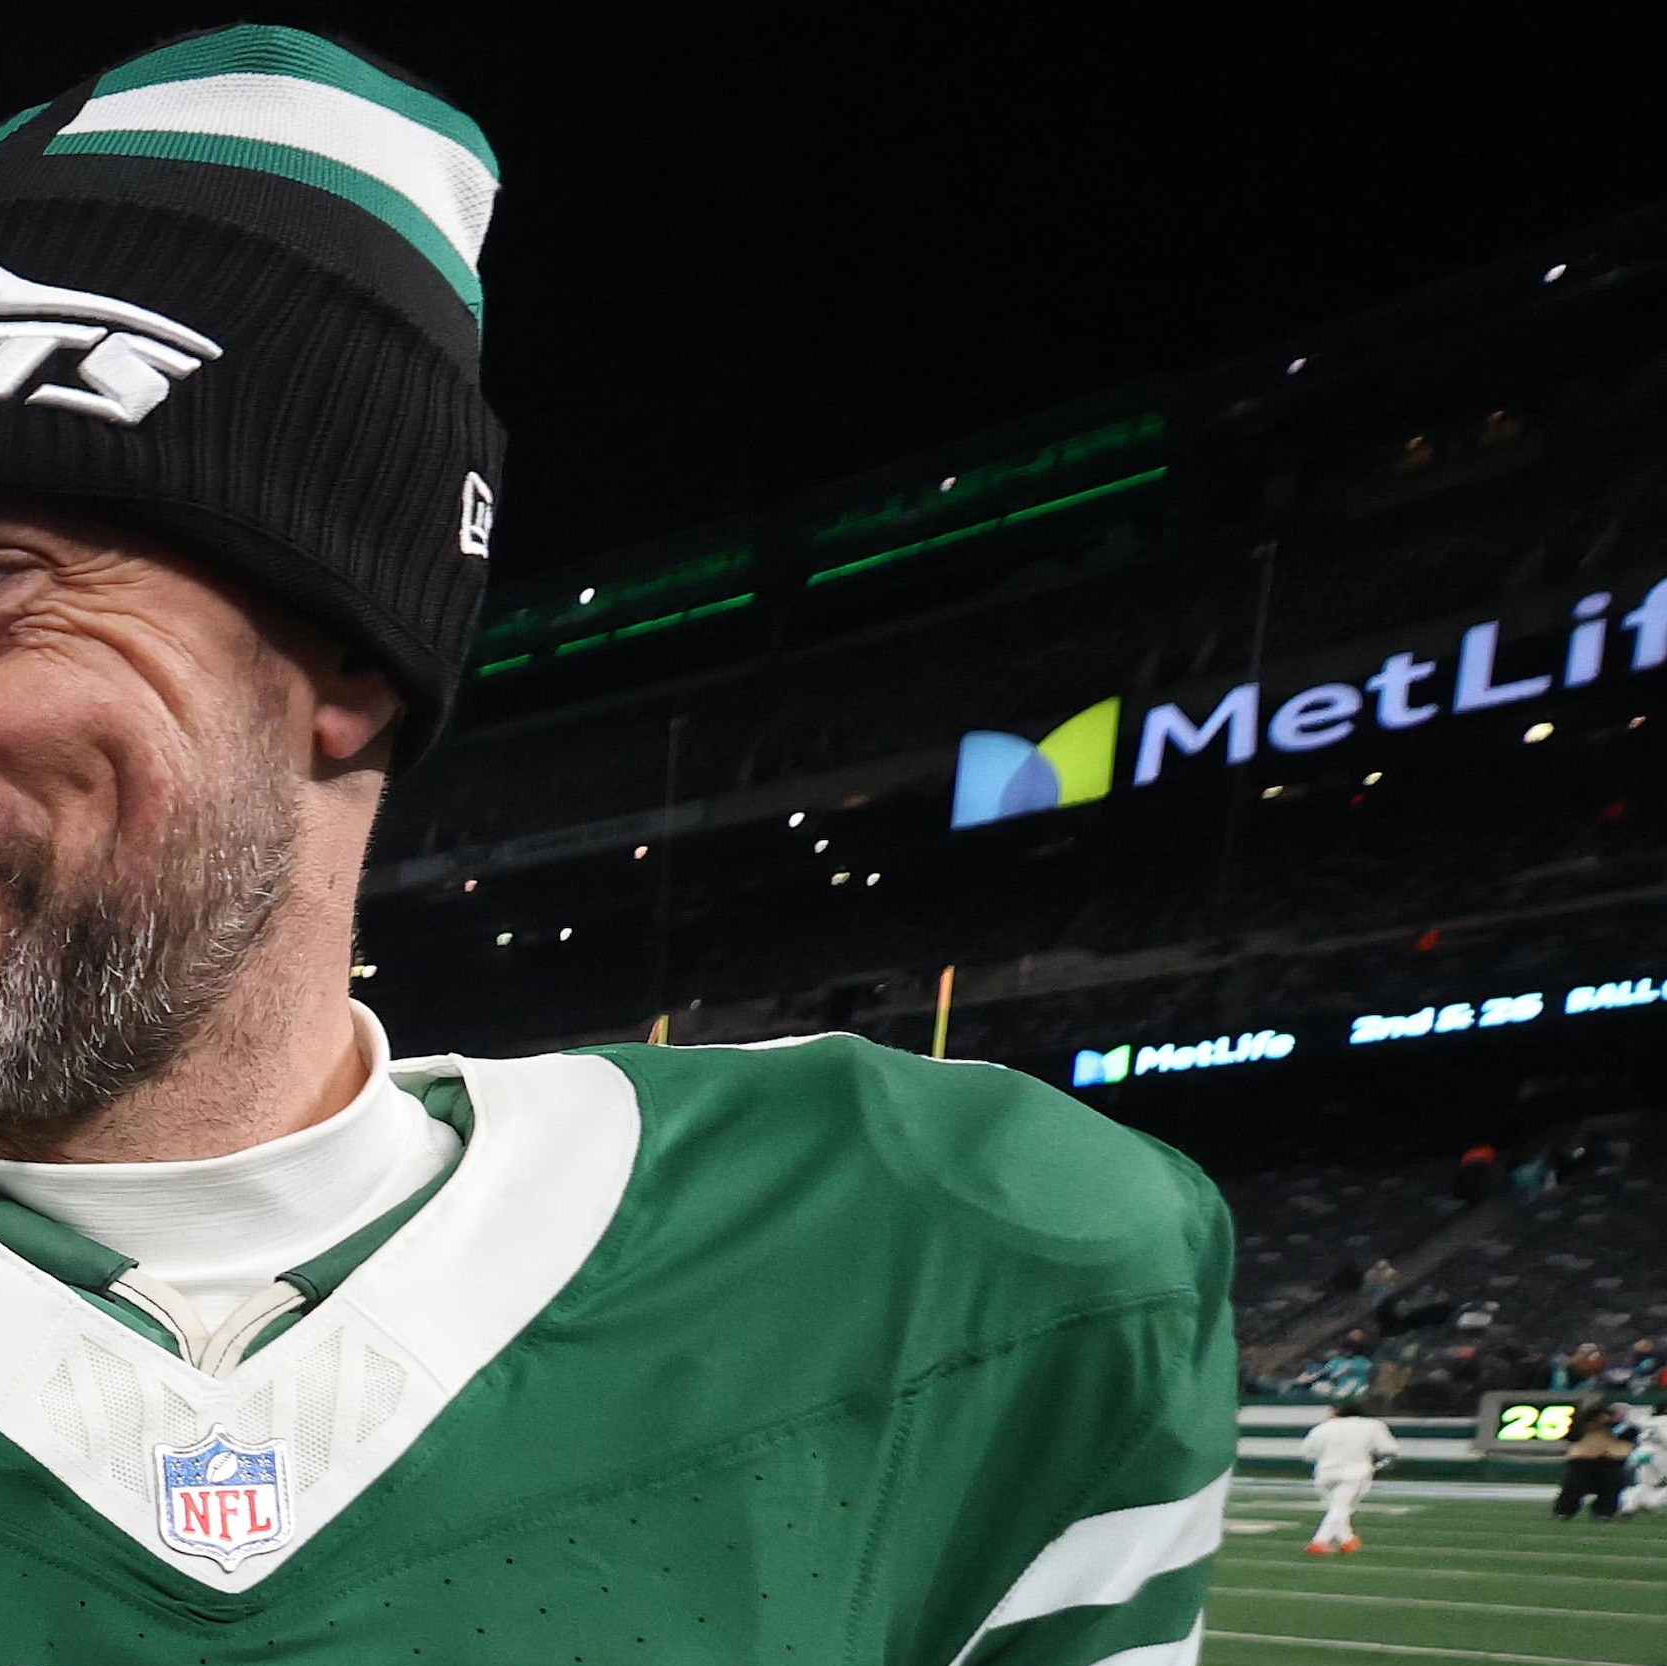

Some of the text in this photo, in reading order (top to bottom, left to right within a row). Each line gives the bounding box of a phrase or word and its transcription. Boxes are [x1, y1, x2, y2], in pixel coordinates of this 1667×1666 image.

[1135, 1030, 1295, 1076] MetLife
[1497, 1405, 1577, 1441] 25
[180, 1489, 272, 1542] NFL
